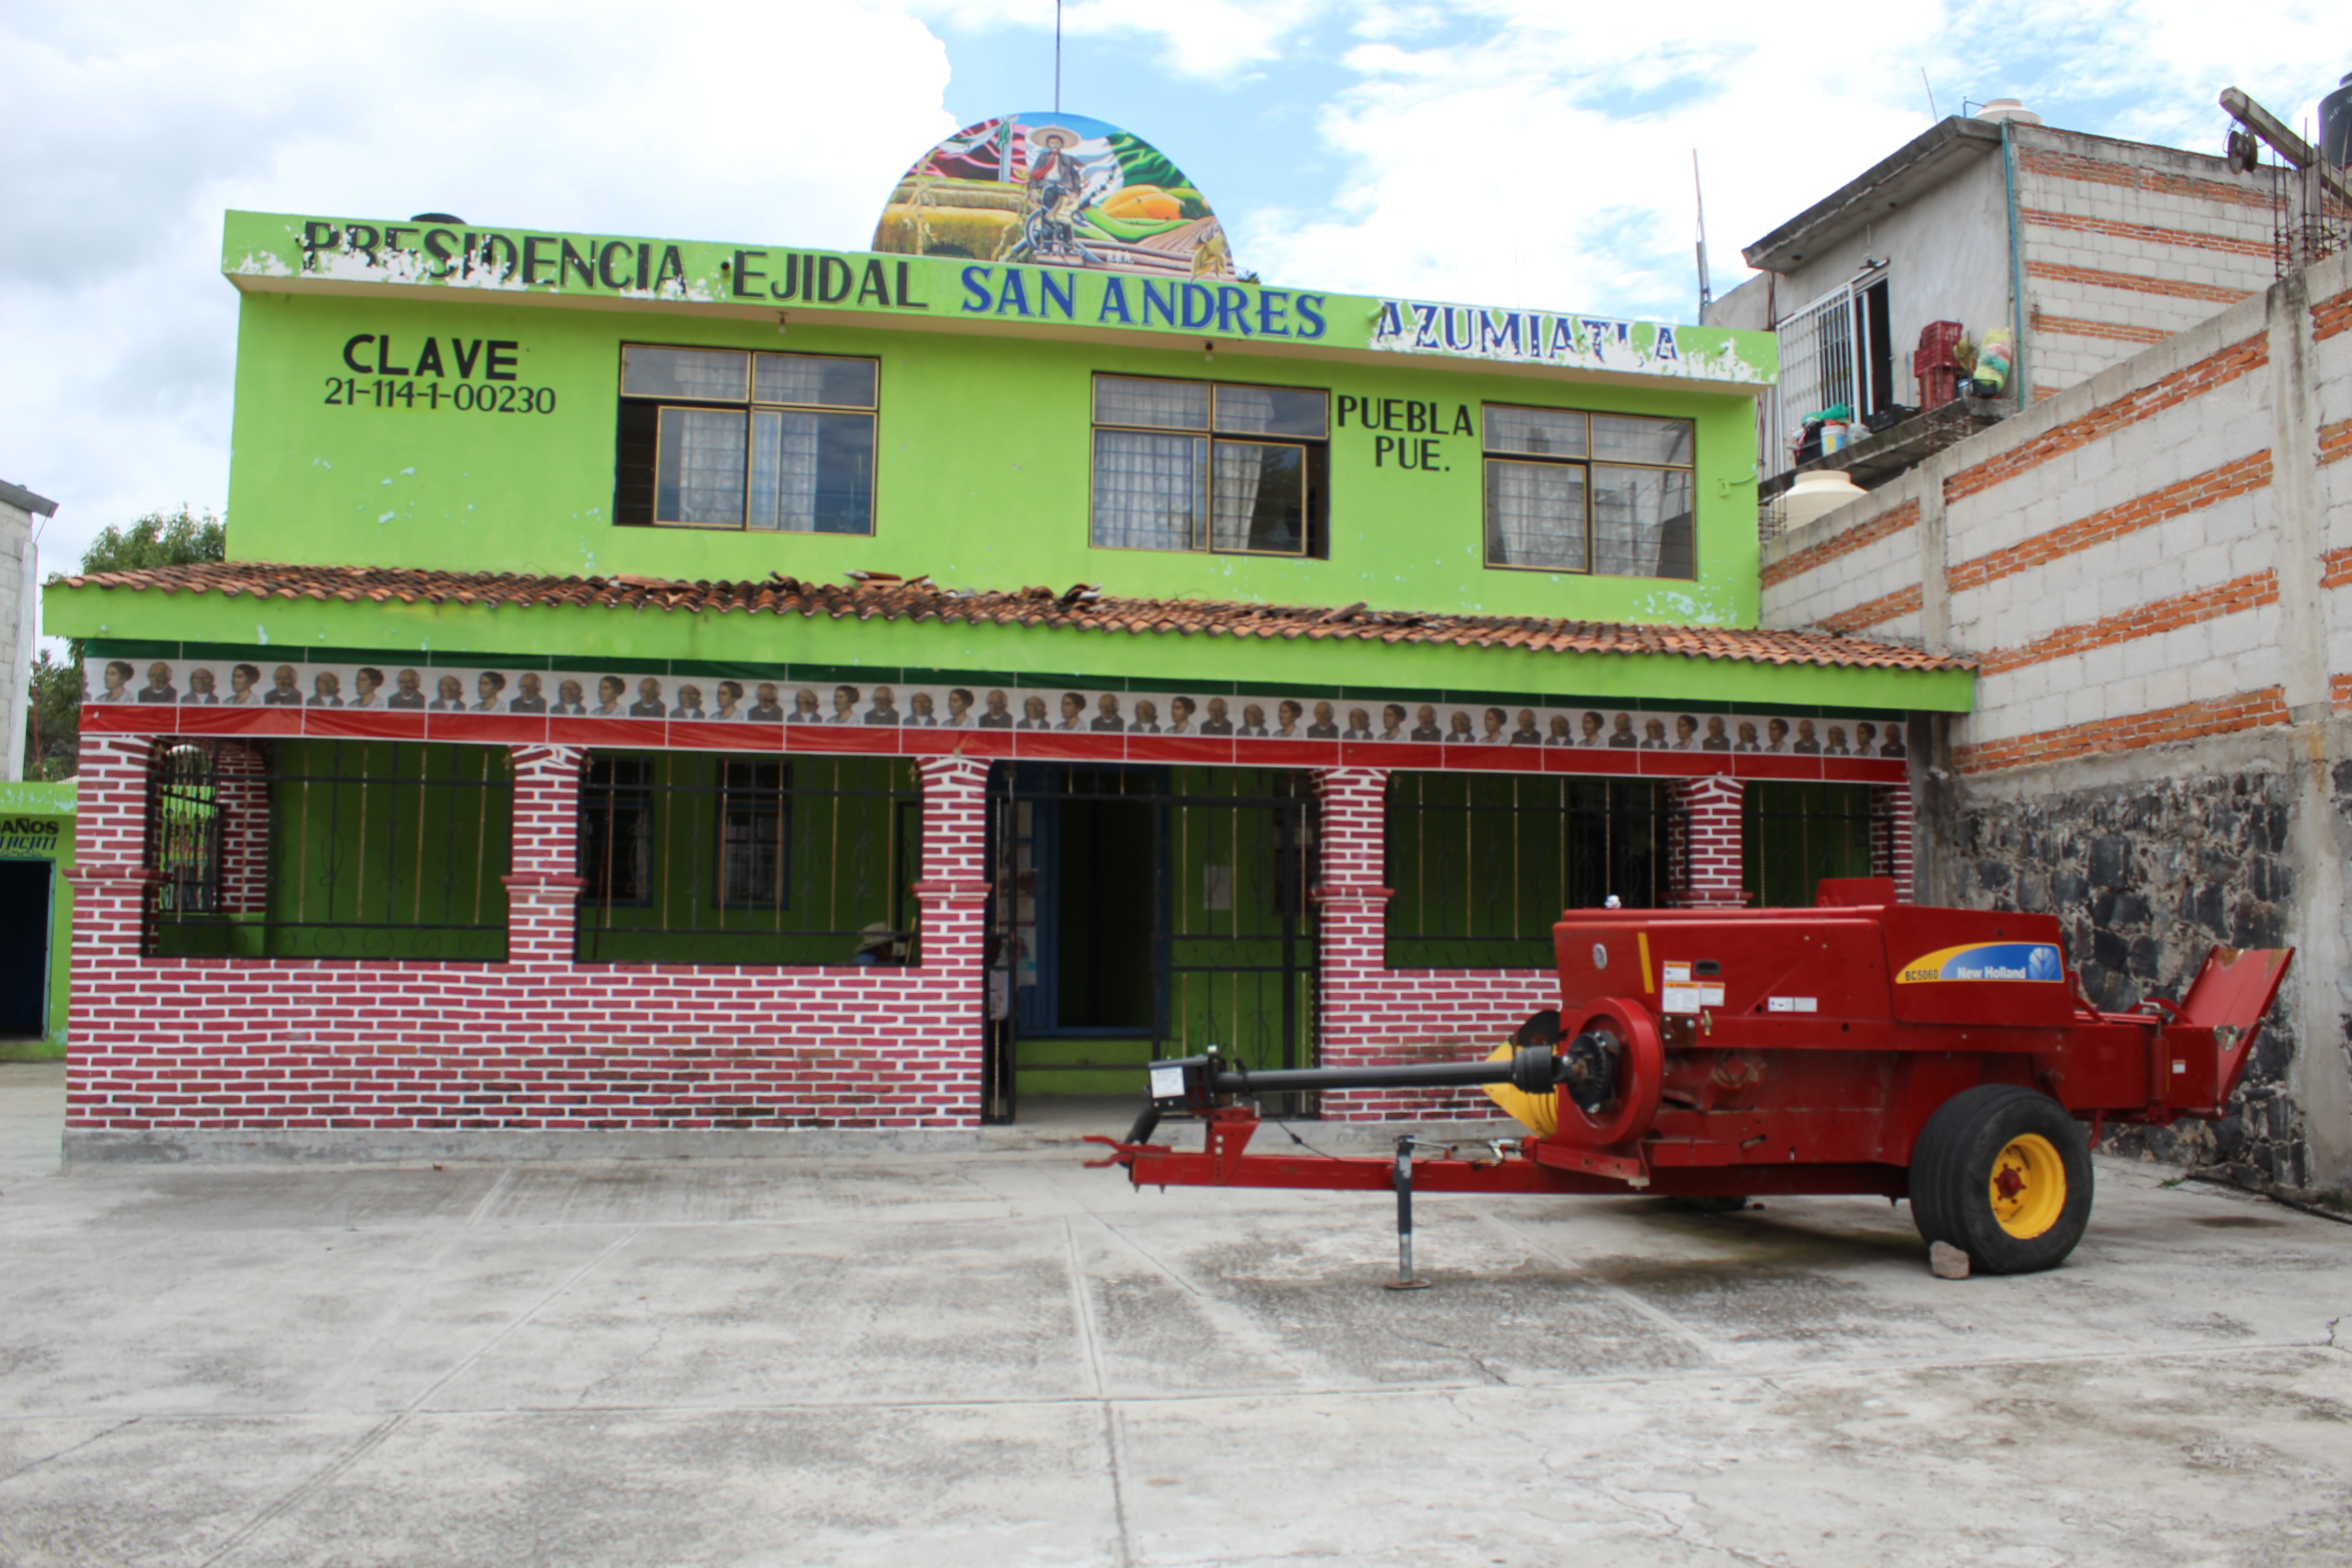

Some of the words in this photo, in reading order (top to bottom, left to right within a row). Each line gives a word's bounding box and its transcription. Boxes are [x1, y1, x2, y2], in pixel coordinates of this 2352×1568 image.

[732, 250, 928, 309] EJIDAL
[961, 266, 1077, 319] SAN
[1098, 276, 1326, 339] ANDRES
[343, 334, 519, 381] CLAVE
[324, 378, 556, 414] 21-114-1-00230
[1338, 395, 1475, 436] PUEBLA
[1375, 436, 1450, 472] PUE.
[0, 818, 59, 835] AÑOS
[1906, 970, 1939, 981] BC5060
[1957, 967, 1983, 979] New
[1984, 965, 2026, 979] Holland
